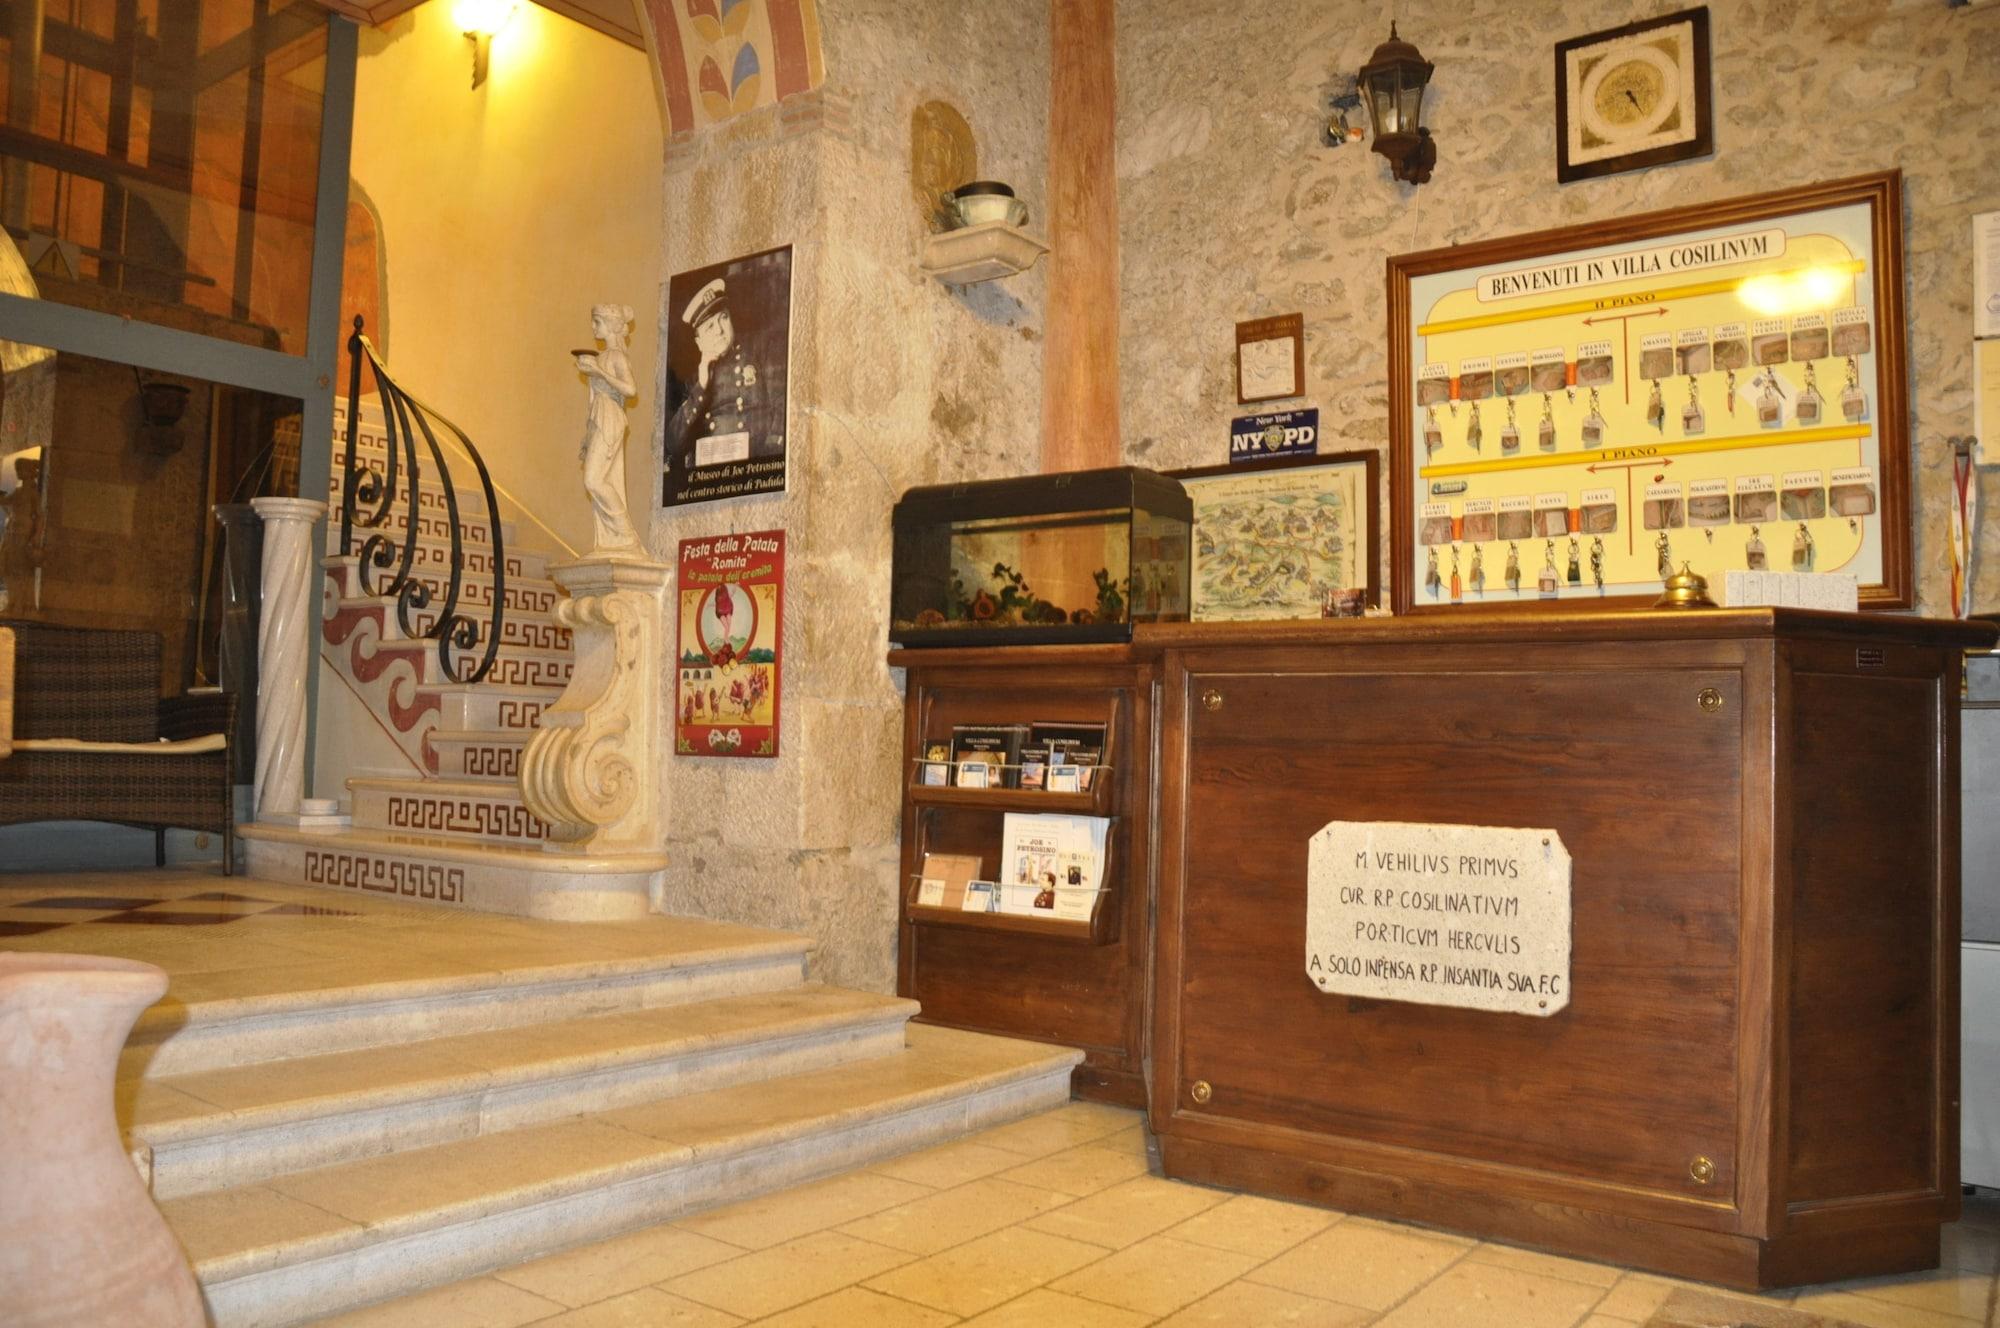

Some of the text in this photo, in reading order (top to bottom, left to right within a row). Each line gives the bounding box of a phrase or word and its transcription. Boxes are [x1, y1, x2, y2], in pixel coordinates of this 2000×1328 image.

[1492, 235, 1768, 296] BENVENUTI IN VILLA COSILINVM
[1612, 294, 1656, 308] PIANO
[1256, 417, 1274, 426] New
[1274, 412, 1293, 424] York
[1614, 447, 1657, 459] PIANO
[694, 469, 721, 481] Museo
[721, 465, 730, 478] di
[730, 465, 745, 479] Joe
[746, 460, 785, 475] Petrosino
[690, 486, 715, 498] centro
[716, 483, 743, 495] storico
[743, 481, 753, 492] di
[754, 475, 785, 489] Padula
[683, 535, 779, 563] Festa della Patata
[1376, 851, 1449, 874] VEHILIVS
[1459, 855, 1518, 879] PRIMVS
[1400, 890, 1518, 917] COSILINATIVM
[1356, 921, 1521, 955] PORTICVM HERCVLIS
[1310, 953, 1322, 971] A
[1328, 954, 1361, 977] SOLO
[1507, 971, 1536, 993] SVA
